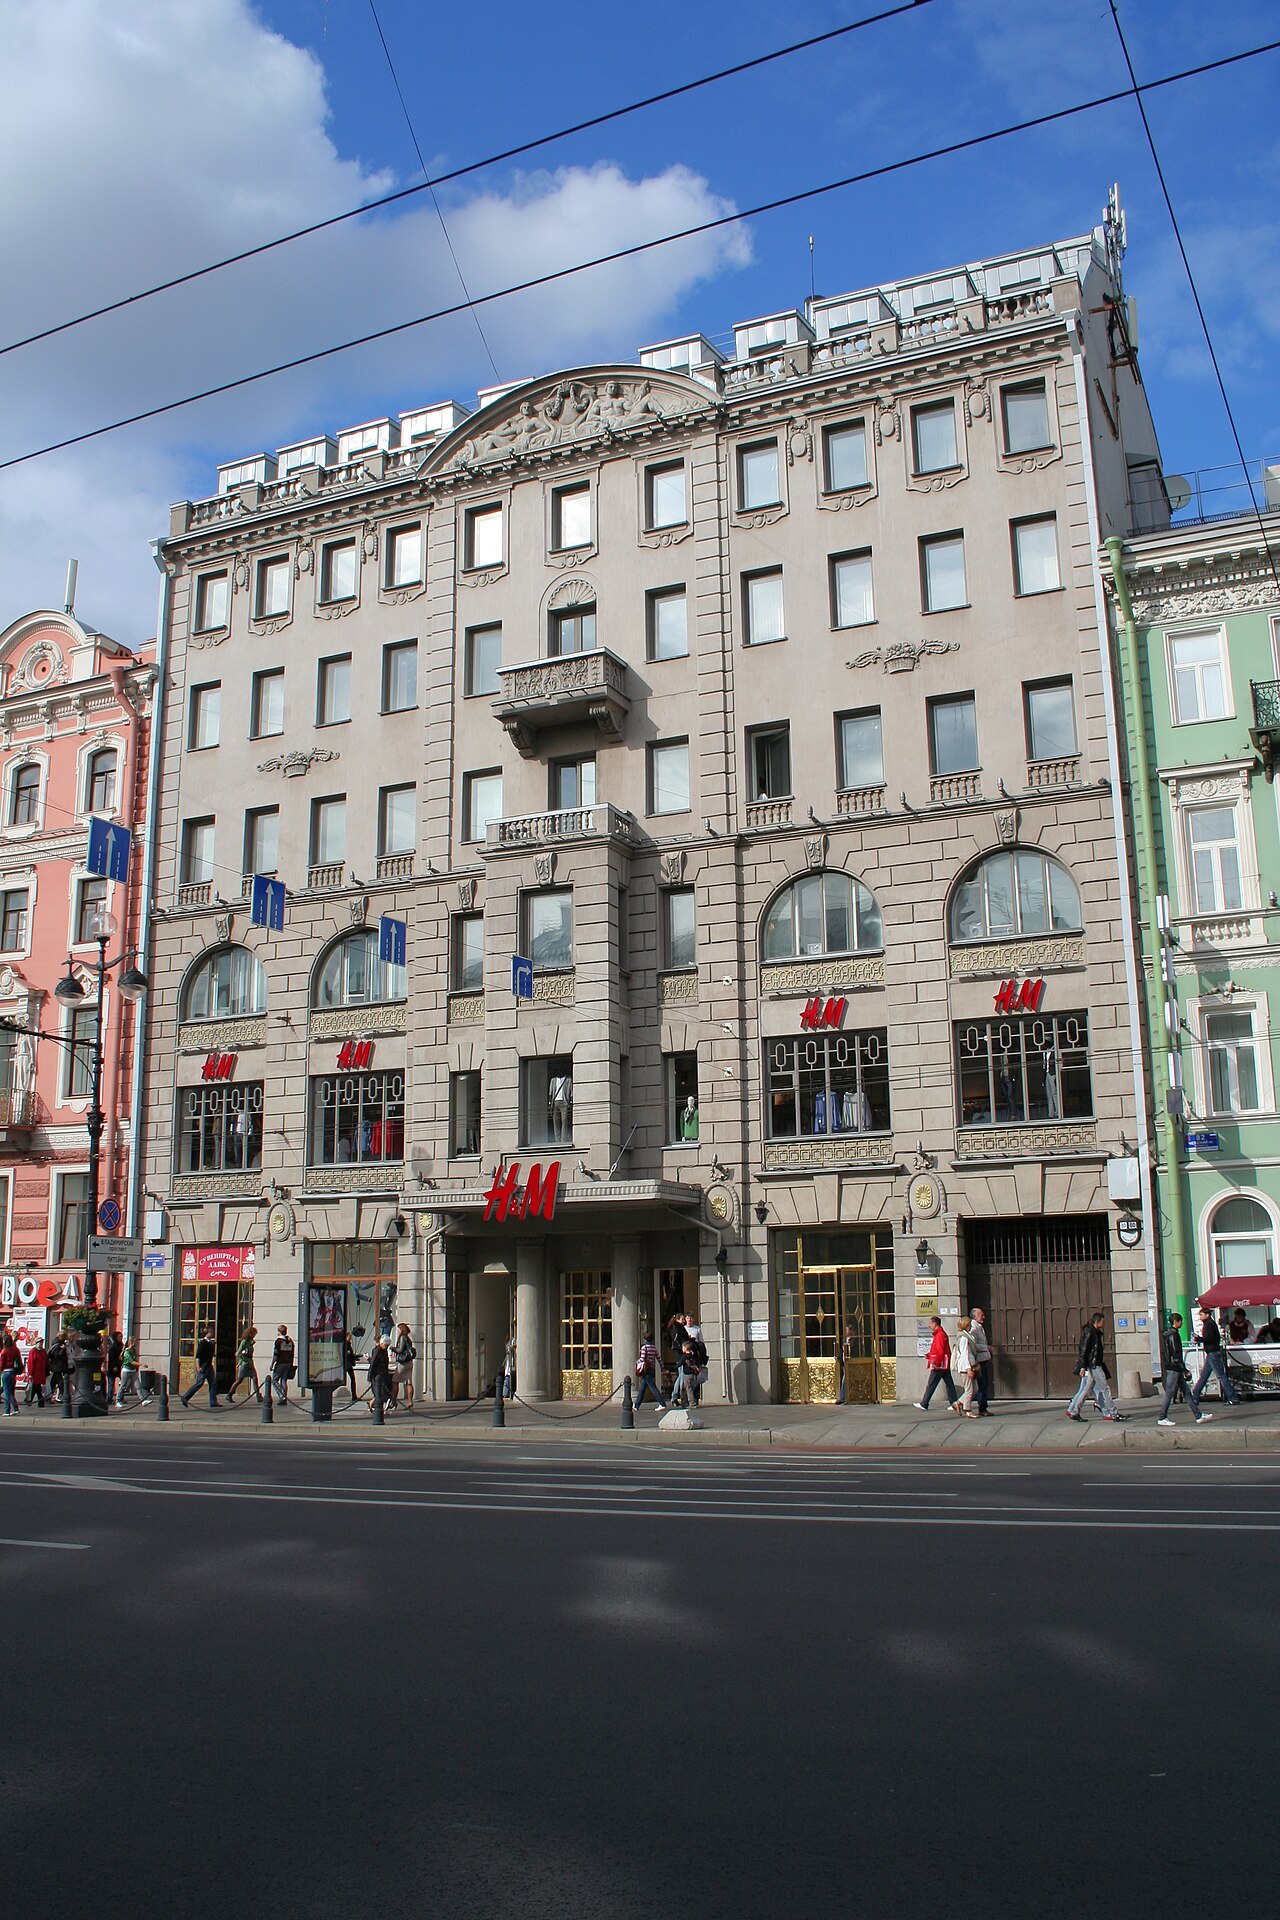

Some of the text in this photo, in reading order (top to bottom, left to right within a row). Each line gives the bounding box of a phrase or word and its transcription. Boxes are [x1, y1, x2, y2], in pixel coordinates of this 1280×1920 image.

[800, 995, 846, 1031] H&M
[993, 977, 1043, 1015] H&M
[201, 1051, 238, 1082] H&M
[336, 1039, 376, 1071] H&M
[483, 1160, 561, 1223] H&M
[199, 1252, 240, 1266] СУВЕНИРНАЯ
